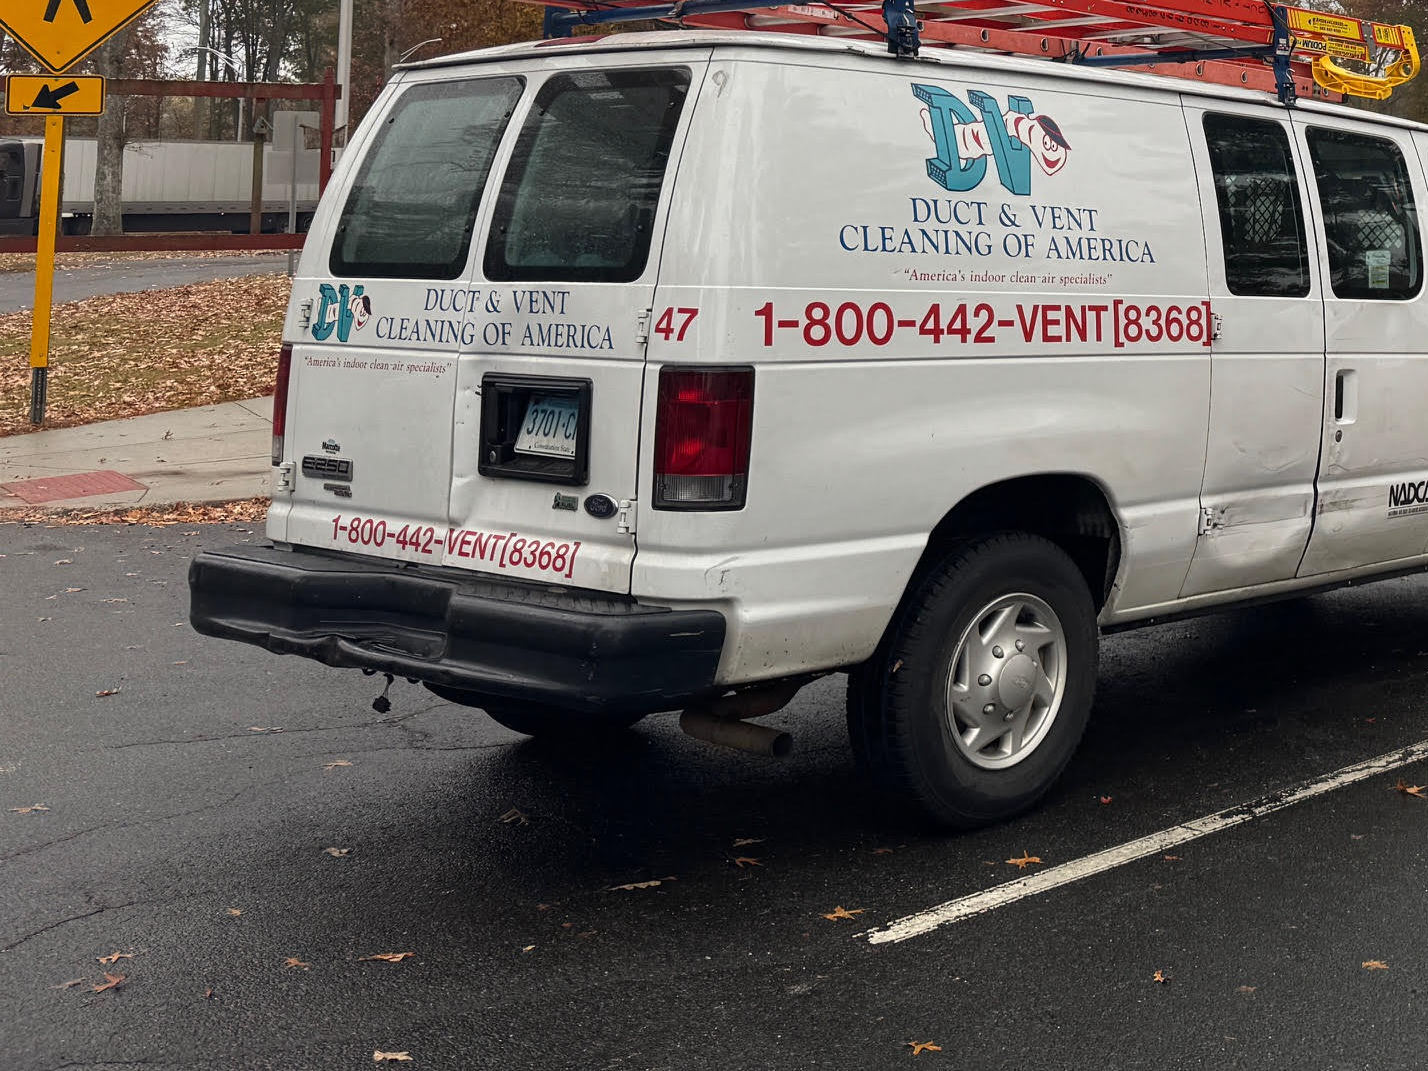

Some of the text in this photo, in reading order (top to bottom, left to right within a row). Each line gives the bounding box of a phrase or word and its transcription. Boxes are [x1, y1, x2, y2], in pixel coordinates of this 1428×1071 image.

[911, 197, 1098, 232] DUCT & VENT
[839, 224, 1156, 264] CLEANING OF AMERICA
[970, 270, 1005, 284] indoor
[423, 288, 570, 315] DUCT & VENT
[375, 316, 614, 350] CLEANING OF AMERICA
[655, 308, 698, 342] 47
[755, 299, 1212, 348] 1-800-442-VENT[8368]
[343, 357, 367, 370] indoor
[332, 514, 580, 578] 1-800-442-VENT[8368]
